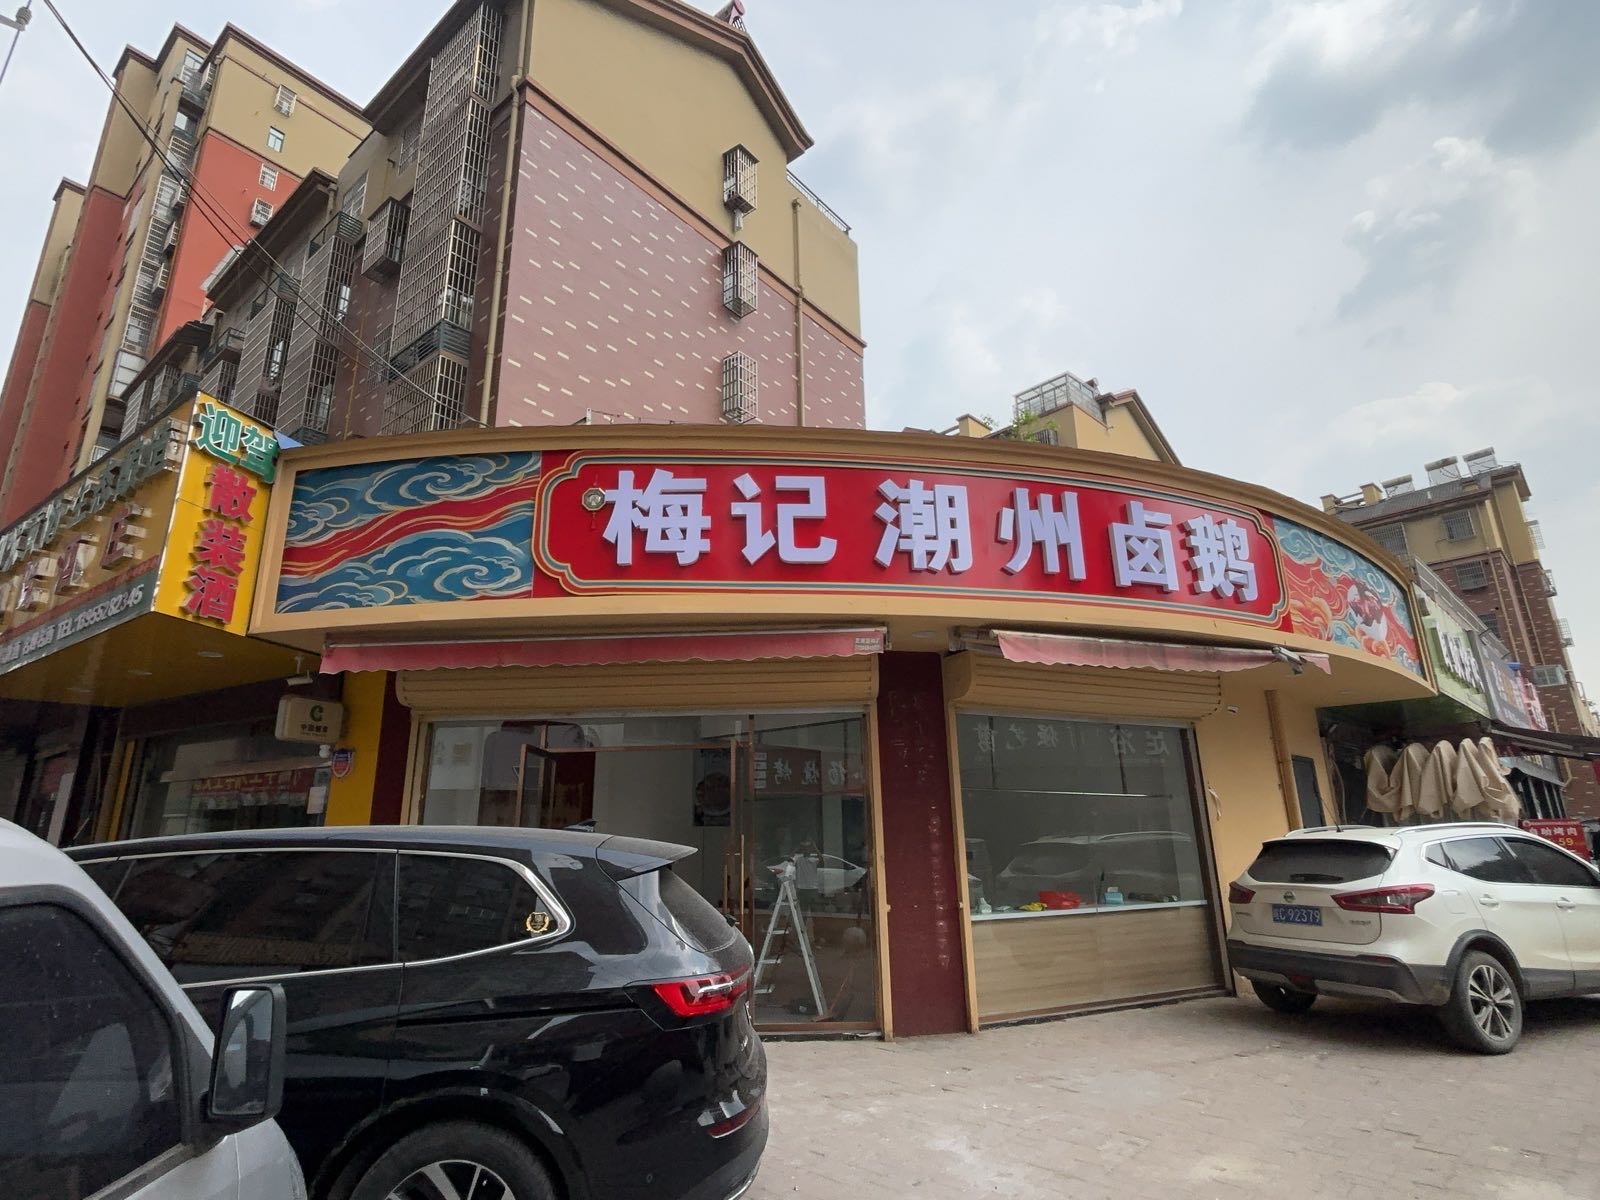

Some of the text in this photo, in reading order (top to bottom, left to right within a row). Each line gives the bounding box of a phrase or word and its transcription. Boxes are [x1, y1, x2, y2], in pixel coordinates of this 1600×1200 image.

[197, 402, 279, 484] 迎驾
[186, 464, 258, 625] 散装酒
[602, 468, 1258, 602] 梅记潮州卤鹅
